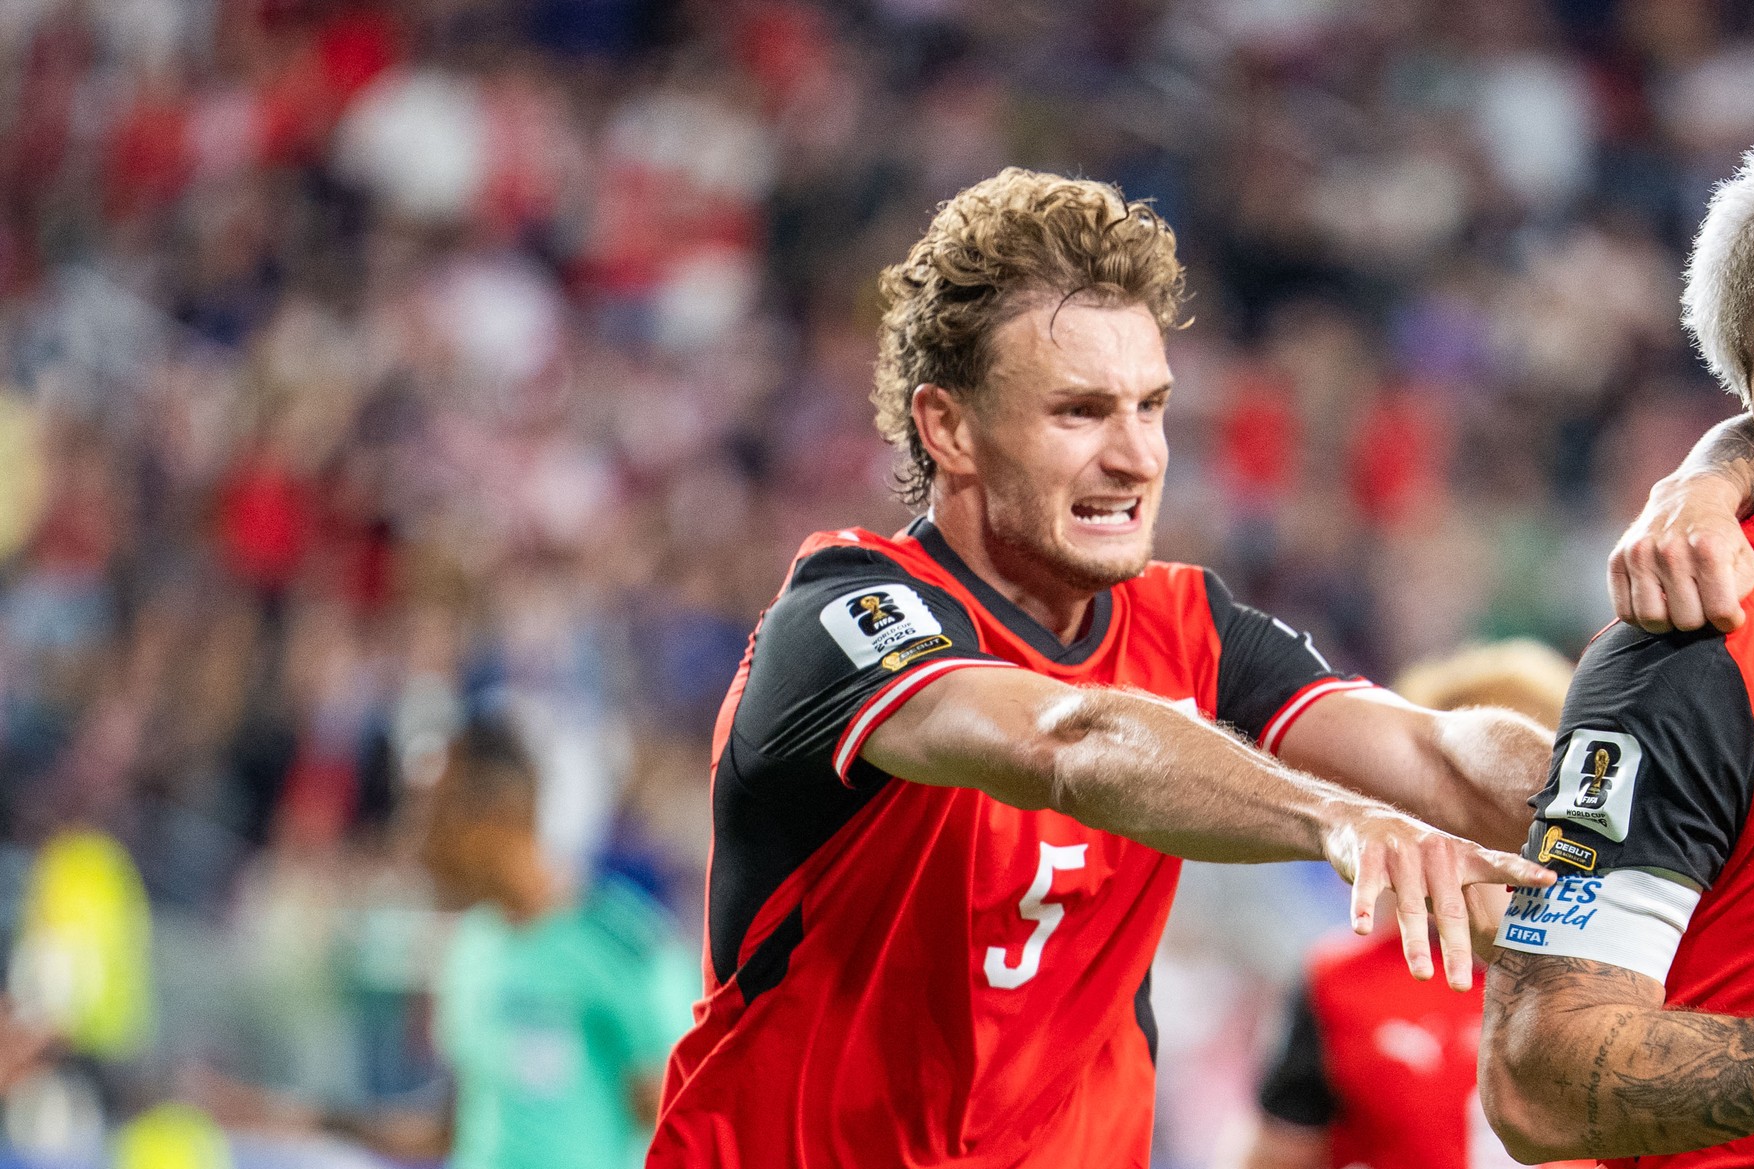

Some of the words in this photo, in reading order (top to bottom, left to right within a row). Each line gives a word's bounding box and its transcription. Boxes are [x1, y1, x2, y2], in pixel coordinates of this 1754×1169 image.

[873, 617, 896, 630] FIFA
[872, 628, 897, 647] WORLD
[897, 622, 912, 630] CUP
[874, 627, 917, 654] 2026
[899, 638, 940, 659] DEBUT
[1582, 796, 1599, 805] FIFA
[1566, 809, 1590, 818] WORLD
[1554, 841, 1592, 859] DEBUT
[983, 840, 1089, 990] 5
[1520, 900, 1598, 931] World
[1508, 926, 1542, 944] FIFA
